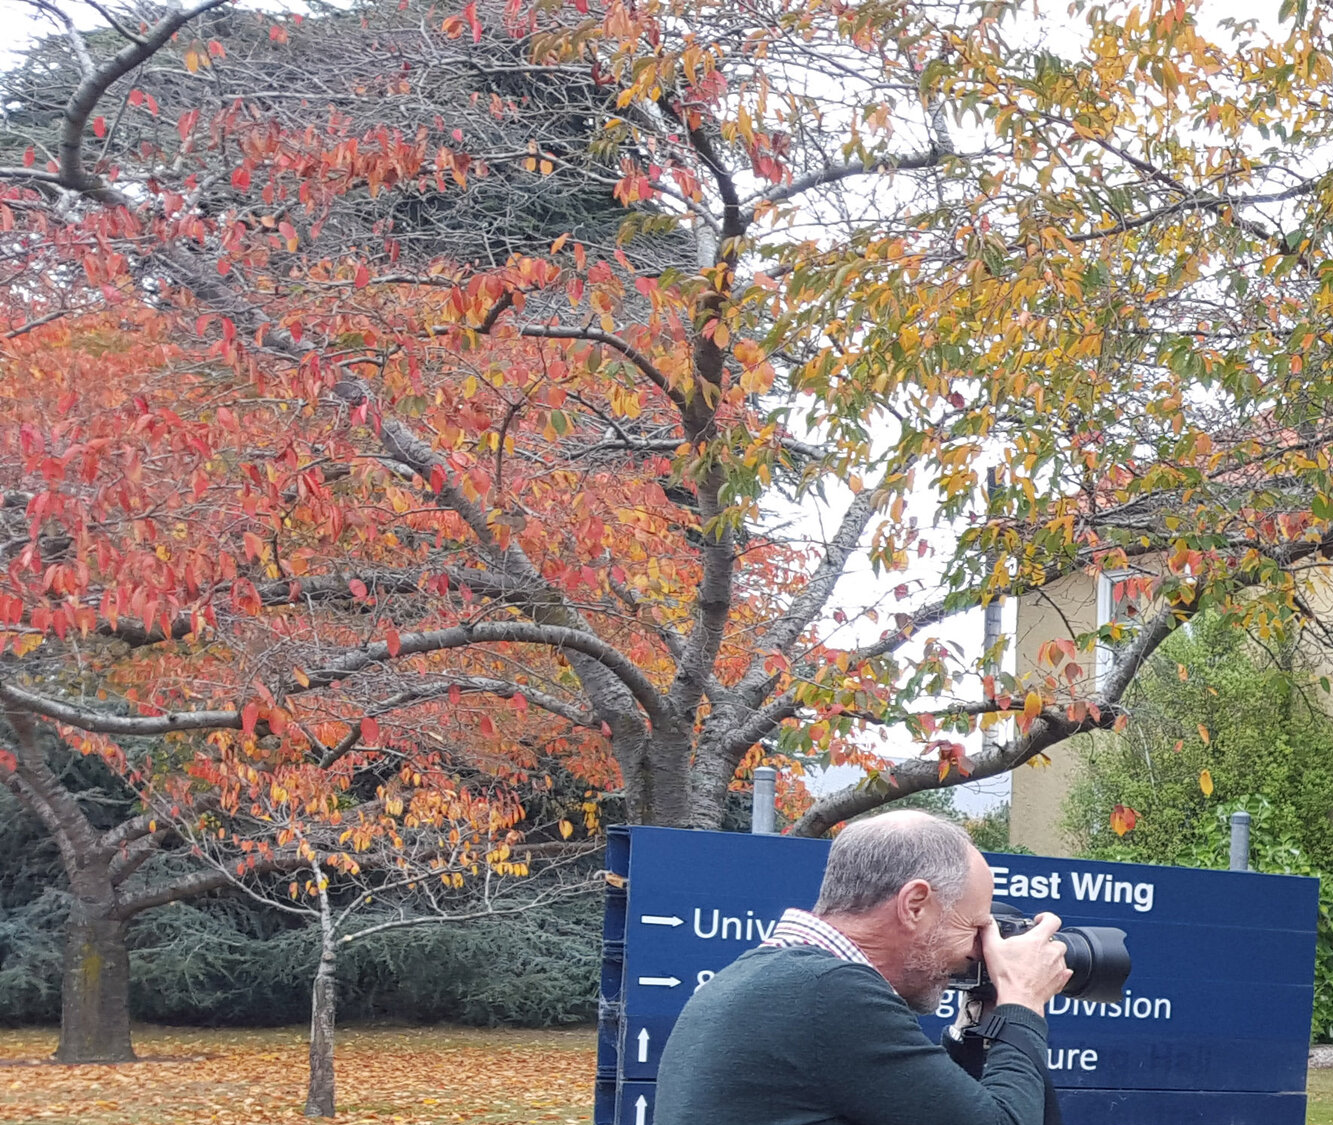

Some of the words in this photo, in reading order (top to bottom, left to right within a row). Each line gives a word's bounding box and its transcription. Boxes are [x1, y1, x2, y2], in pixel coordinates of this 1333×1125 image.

[989, 866, 1061, 900] East
[1071, 872, 1154, 912] Wing
[693, 908, 776, 941] Univ
[1049, 990, 1172, 1019] Division
[1047, 1047, 1098, 1070] ure
